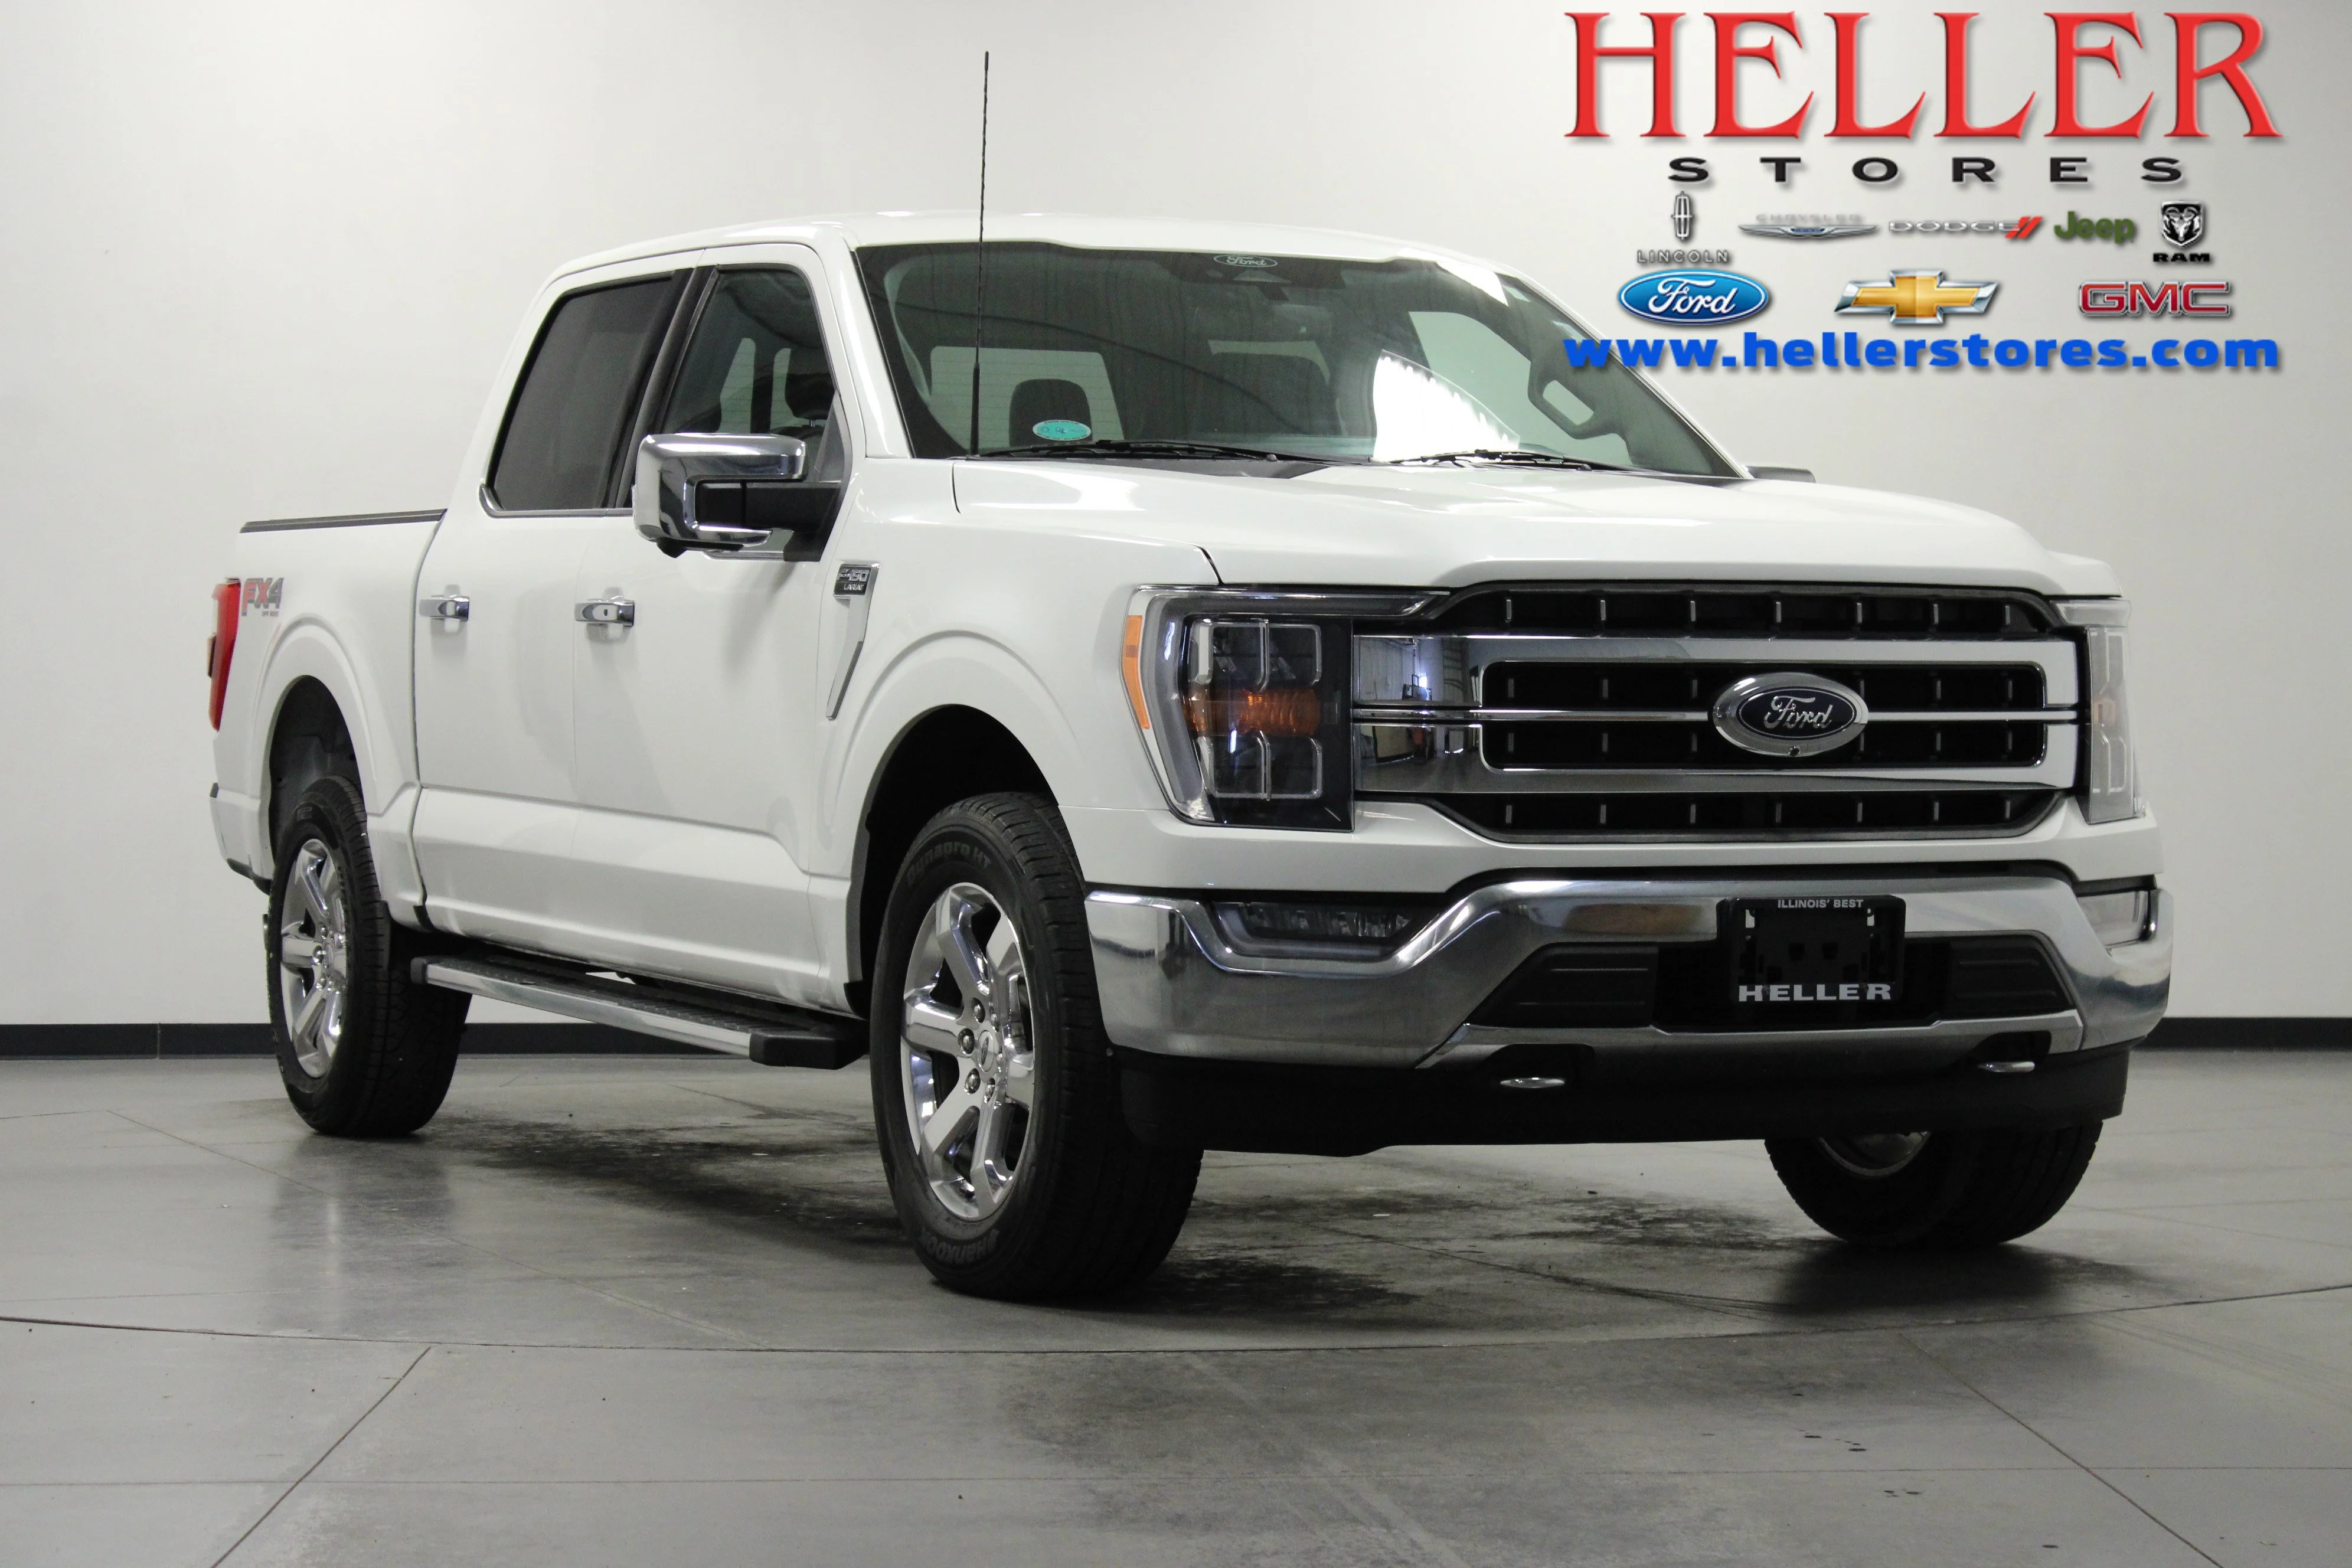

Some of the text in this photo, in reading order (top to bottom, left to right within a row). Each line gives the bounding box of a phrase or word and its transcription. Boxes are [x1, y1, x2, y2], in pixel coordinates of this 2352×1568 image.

[1226, 256, 1268, 266] Ford
[241, 577, 284, 616] FX4
[1763, 695, 1833, 729] Ford
[1777, 899, 1864, 909] ILLINOIS' BEST
[1739, 984, 1892, 1002] HELLER
